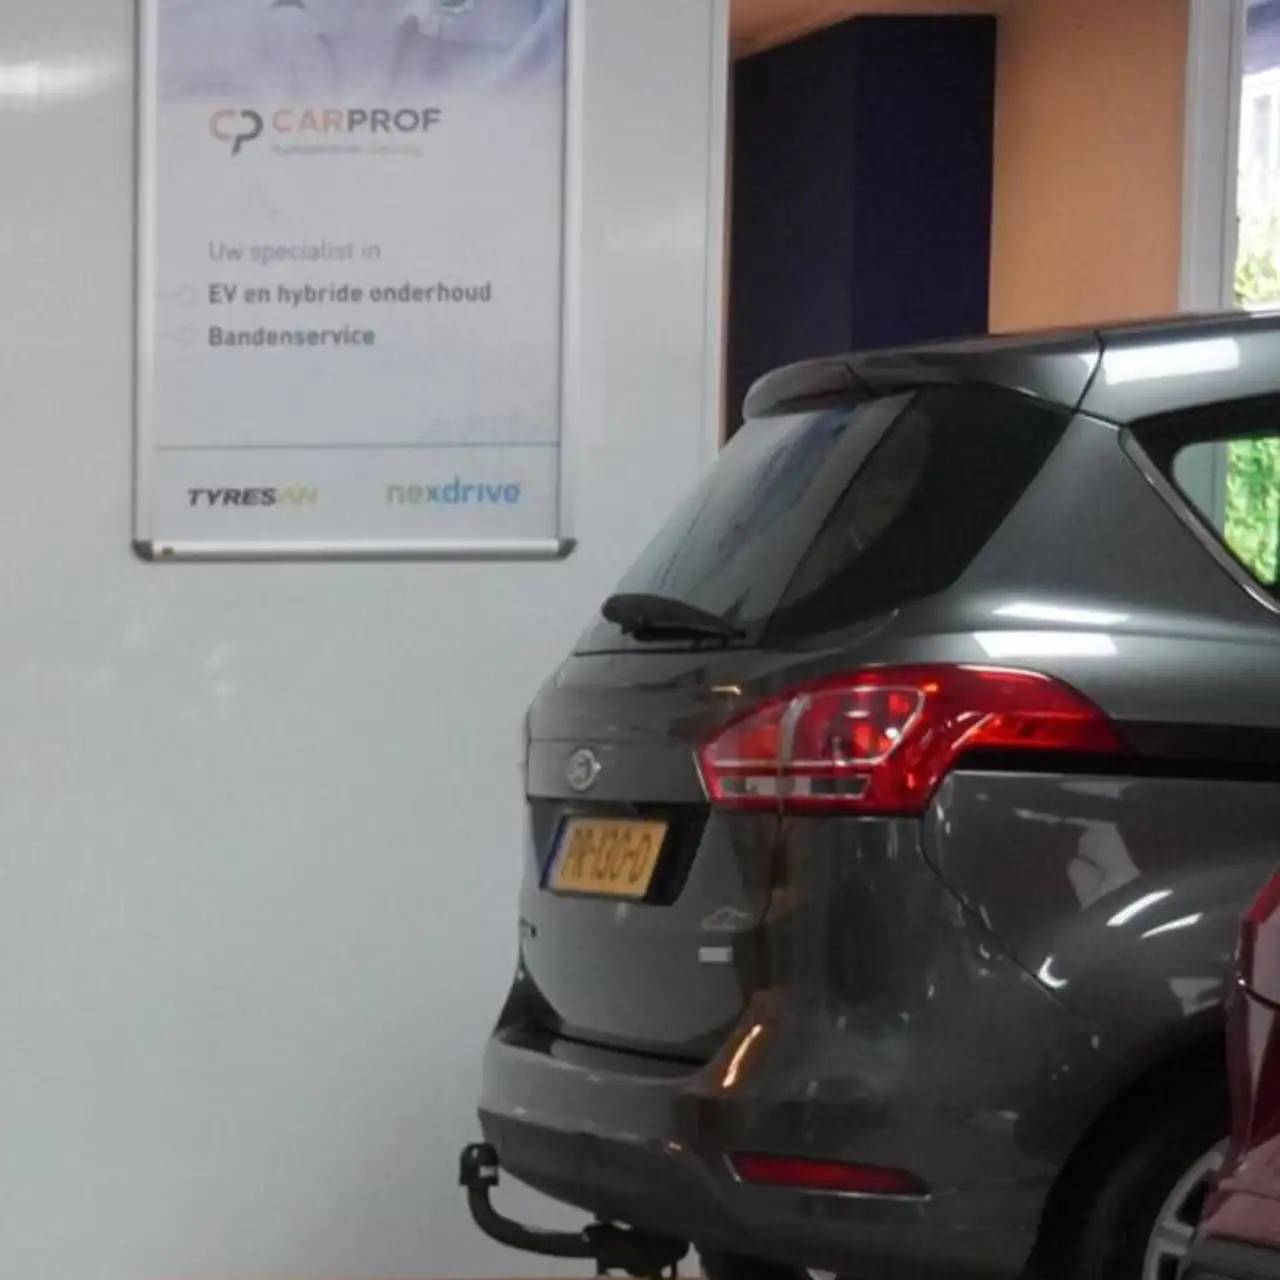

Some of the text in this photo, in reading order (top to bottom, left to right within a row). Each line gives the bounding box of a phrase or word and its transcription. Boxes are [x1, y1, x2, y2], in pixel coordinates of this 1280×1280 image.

[272, 108, 441, 133] CARPROF
[208, 241, 382, 264] Uw specialist in
[208, 281, 492, 308] EV en hybride onderhoud
[208, 325, 376, 347] Bandenservice
[385, 474, 522, 505] nexdrive
